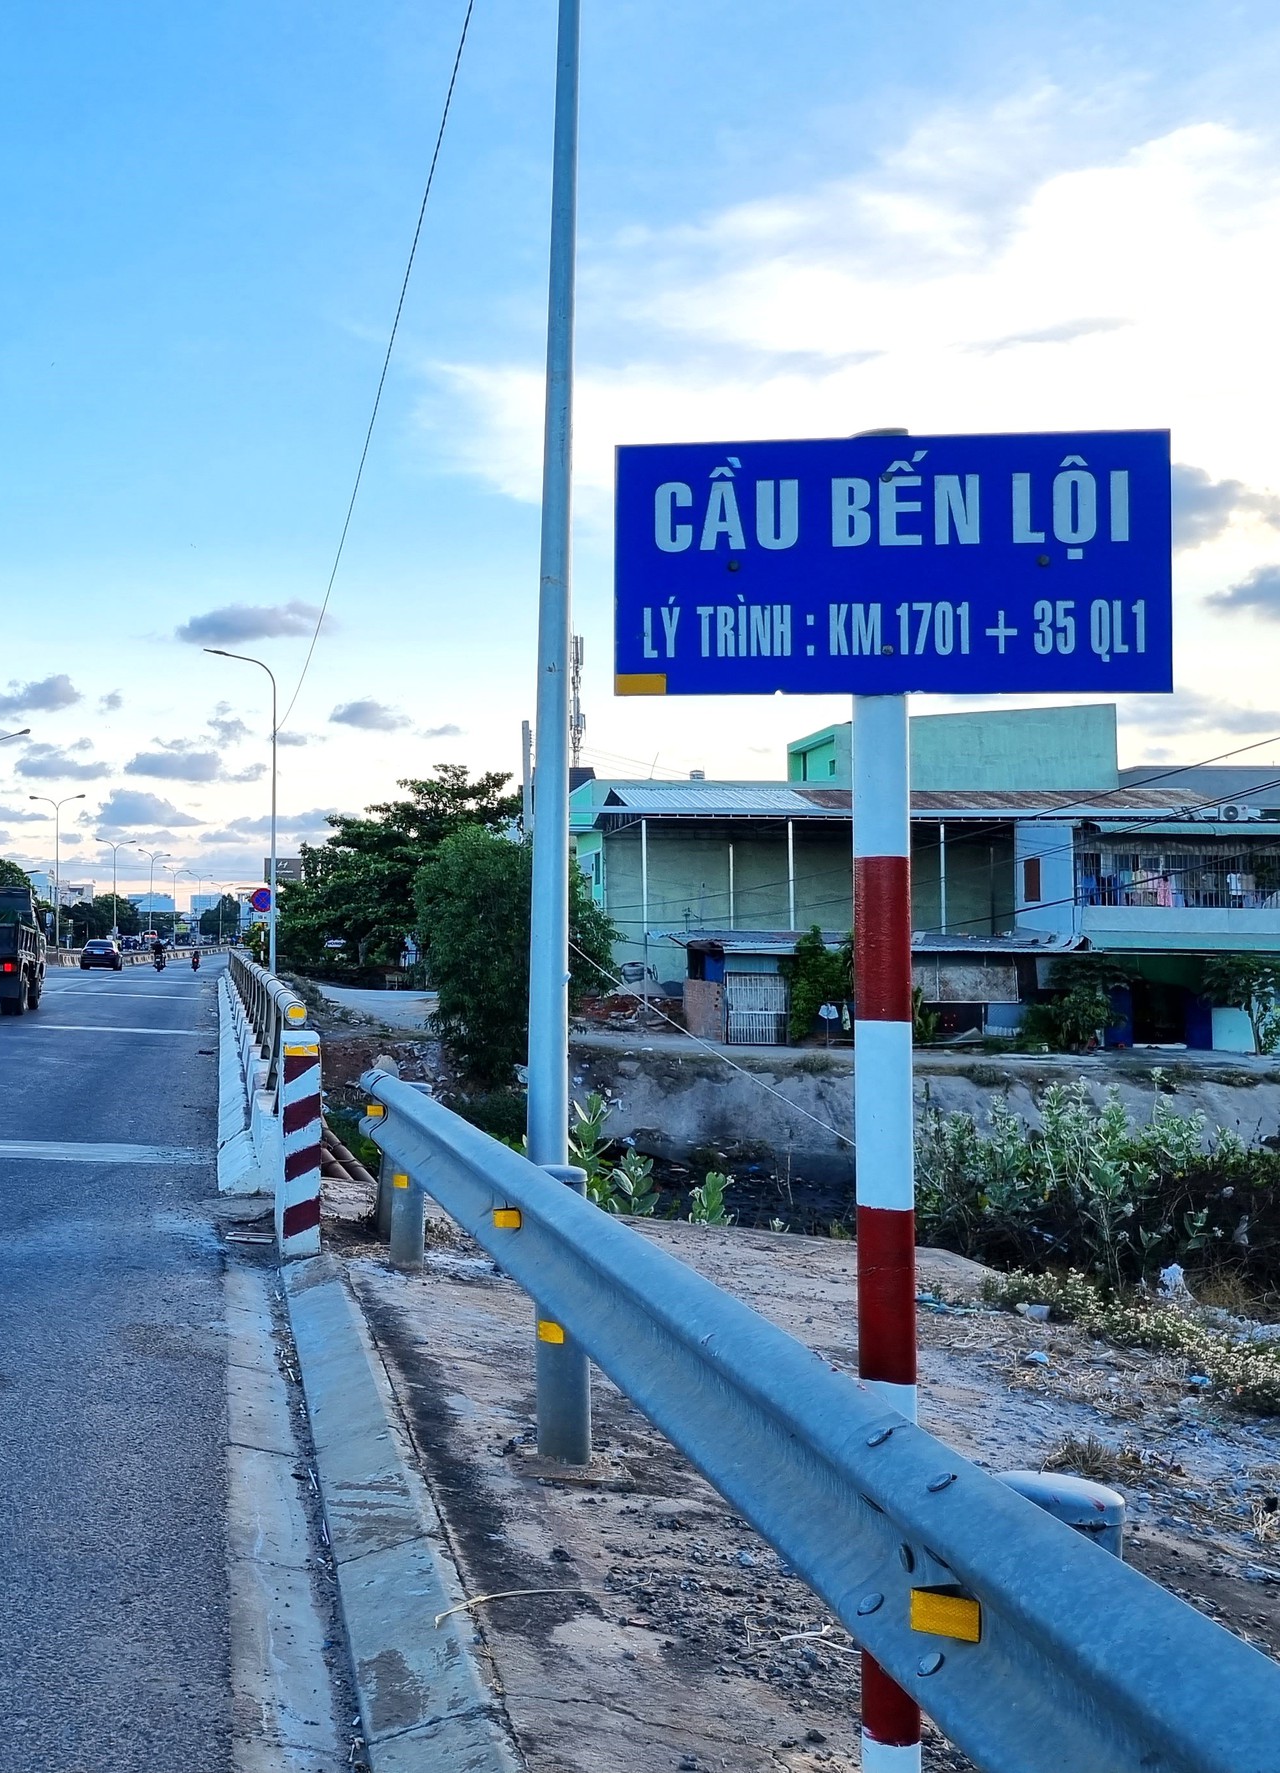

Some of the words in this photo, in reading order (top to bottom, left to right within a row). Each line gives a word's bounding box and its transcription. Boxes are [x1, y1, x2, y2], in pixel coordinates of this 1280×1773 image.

[654, 457, 799, 552] CẦU
[832, 450, 980, 547] BẾN
[1012, 455, 1129, 559] LỘI
[643, 597, 680, 658] LÝ
[697, 594, 792, 657] TRÌNH
[1034, 600, 1075, 654] 35
[1090, 599, 1146, 662] QL1
